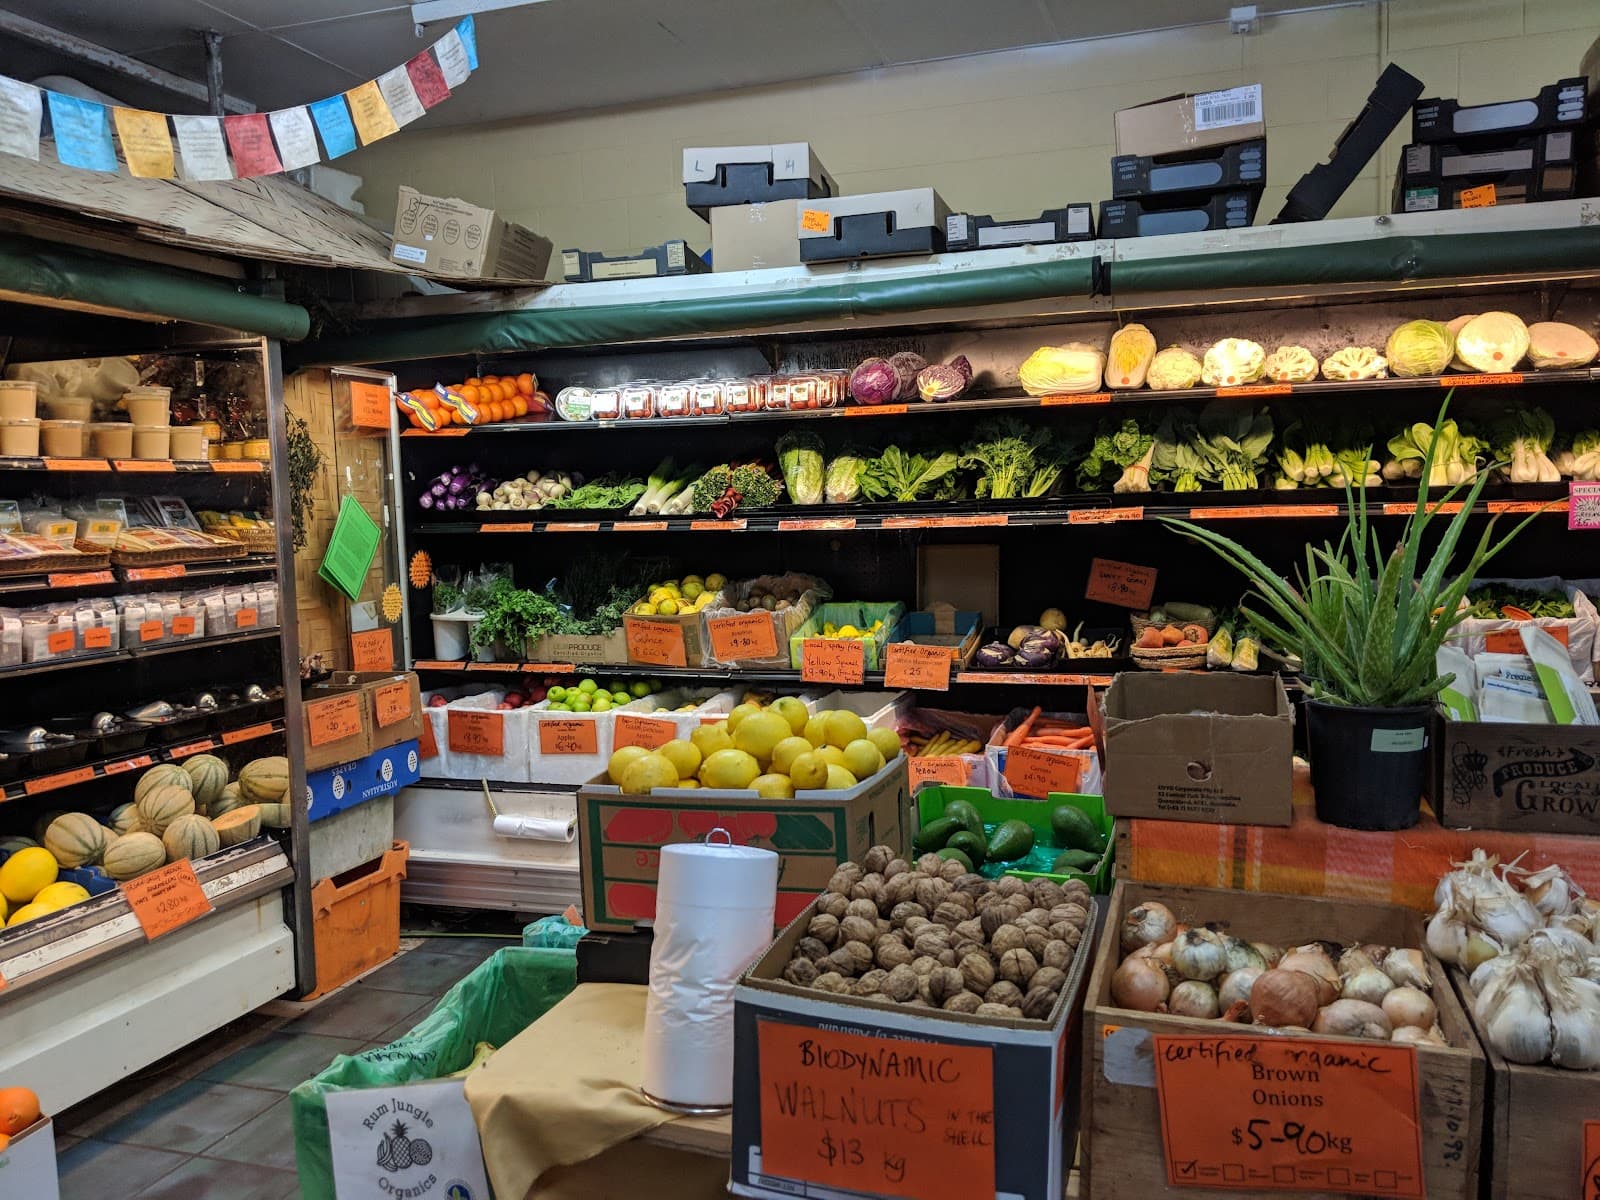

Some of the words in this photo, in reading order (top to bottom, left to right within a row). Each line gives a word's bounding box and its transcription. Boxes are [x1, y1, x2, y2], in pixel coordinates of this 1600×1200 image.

[804, 653, 832, 666] Yellow
[1506, 745, 1556, 758] Fresh
[1502, 760, 1579, 780] PRODUCE
[362, 779, 398, 800] AUSTRALIAN
[799, 1038, 961, 1084] BIODYNAMIC
[1166, 1040, 1259, 1068] certified
[1285, 1050, 1392, 1074] rganic
[1252, 1064, 1321, 1083] Brown
[774, 1081, 927, 1134] WALNUTS
[1252, 1087, 1325, 1108] Onions
[362, 1101, 390, 1132] Rum
[391, 1097, 435, 1129] Jungle
[946, 1108, 958, 1122] IN
[968, 1110, 994, 1126] THE
[816, 1129, 865, 1168] $13
[944, 1129, 993, 1147] SHELL
[378, 1173, 438, 1200] Organics
